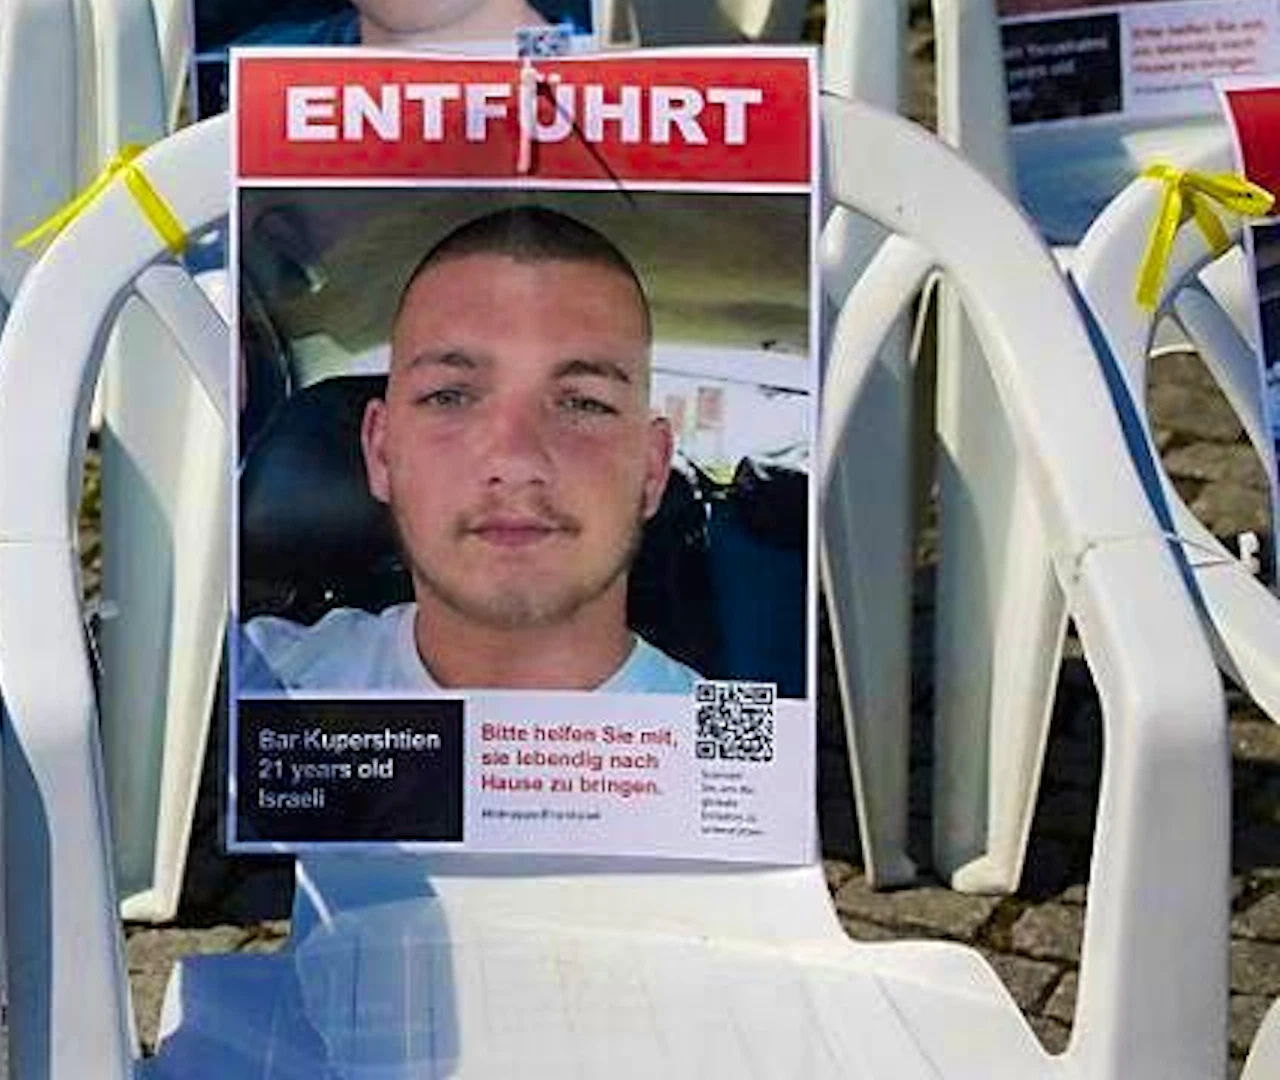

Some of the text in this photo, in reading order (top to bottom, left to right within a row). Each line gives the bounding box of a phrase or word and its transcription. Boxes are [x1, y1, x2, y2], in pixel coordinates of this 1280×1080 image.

[286, 73, 762, 145] ENTFÜHRT
[258, 728, 441, 755] Bar Kupershtien
[482, 723, 678, 747] Bitte helfen Sie mit,
[258, 757, 394, 785] 21 years old
[482, 751, 659, 770] sie lebendig nach
[482, 775, 542, 790] Hause
[551, 778, 572, 792] zu
[258, 787, 326, 809] Israeli
